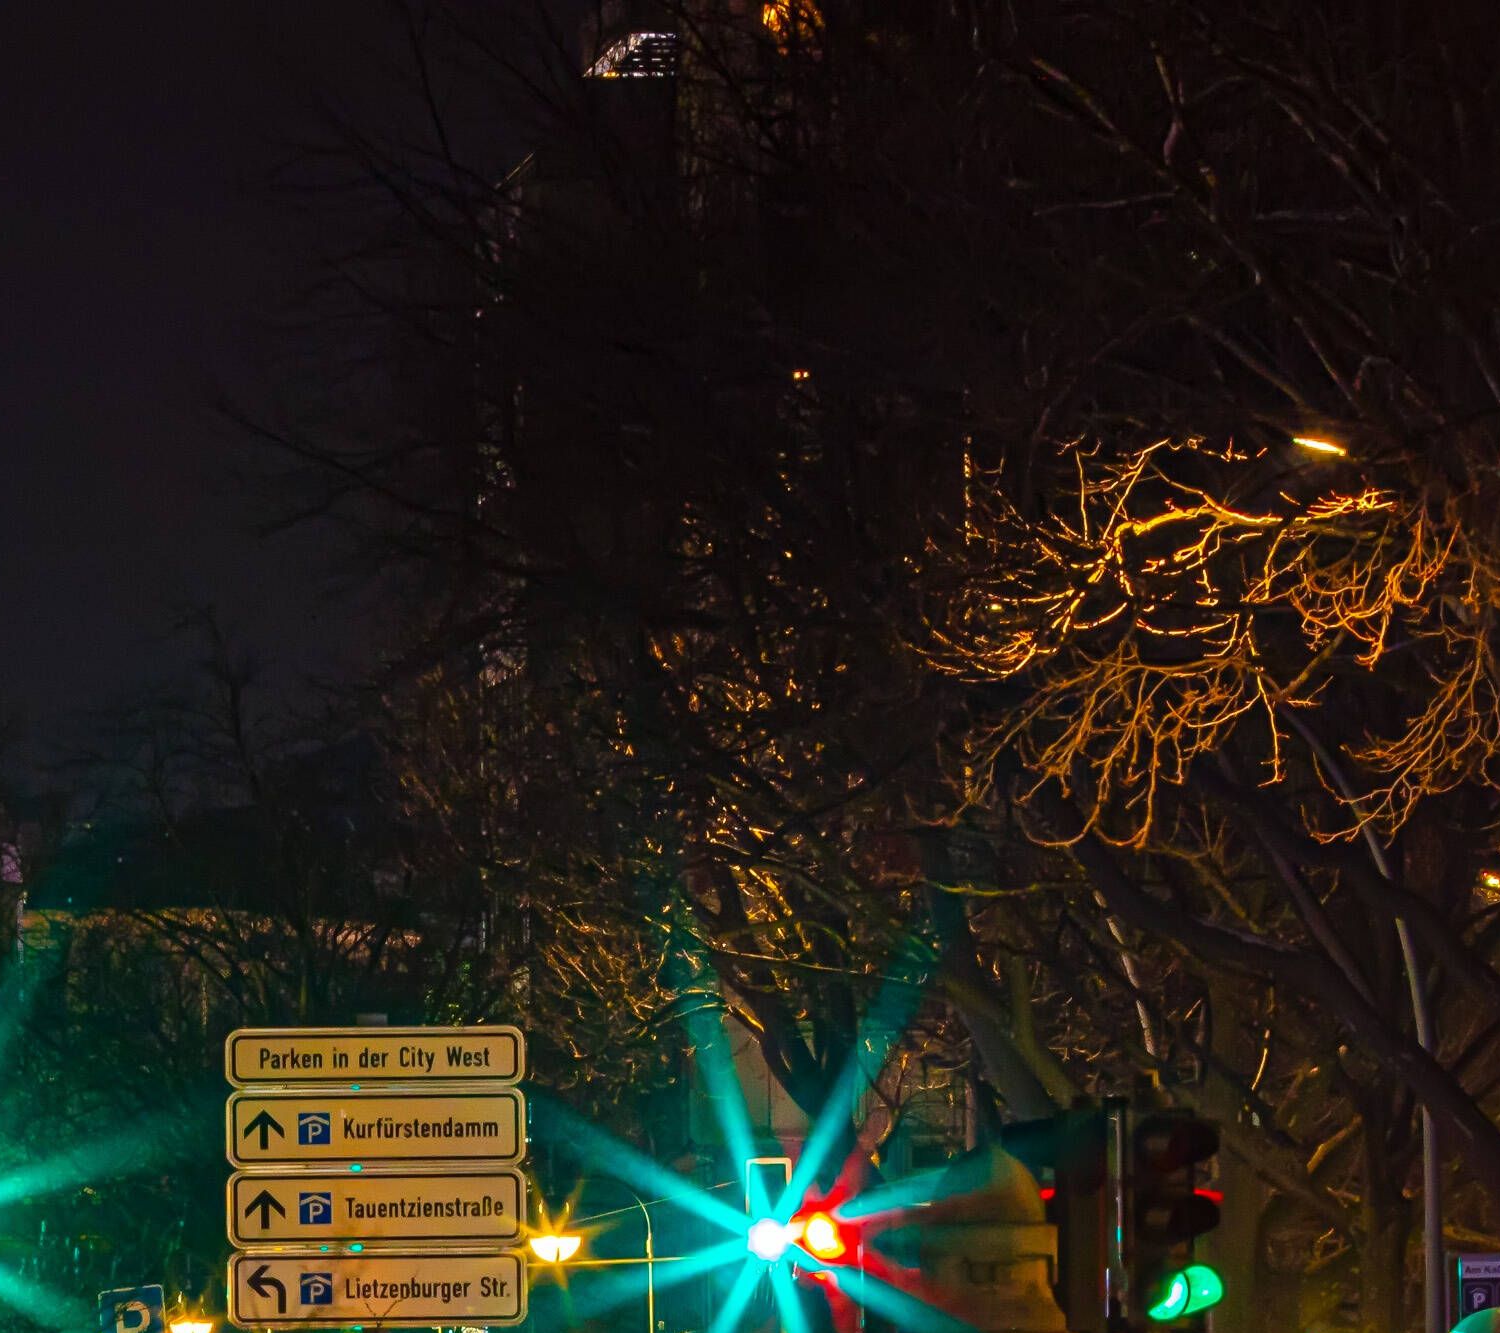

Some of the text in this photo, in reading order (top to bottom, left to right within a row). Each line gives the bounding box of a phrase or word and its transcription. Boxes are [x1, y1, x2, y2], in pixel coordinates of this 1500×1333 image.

[259, 1046, 491, 1072] Parken in der City West
[343, 1117, 499, 1139] Kurfürstendamm
[344, 1196, 504, 1219] Tauentzienstraße
[345, 1277, 471, 1304] Lietzenburger
[480, 1277, 511, 1298] Str.
